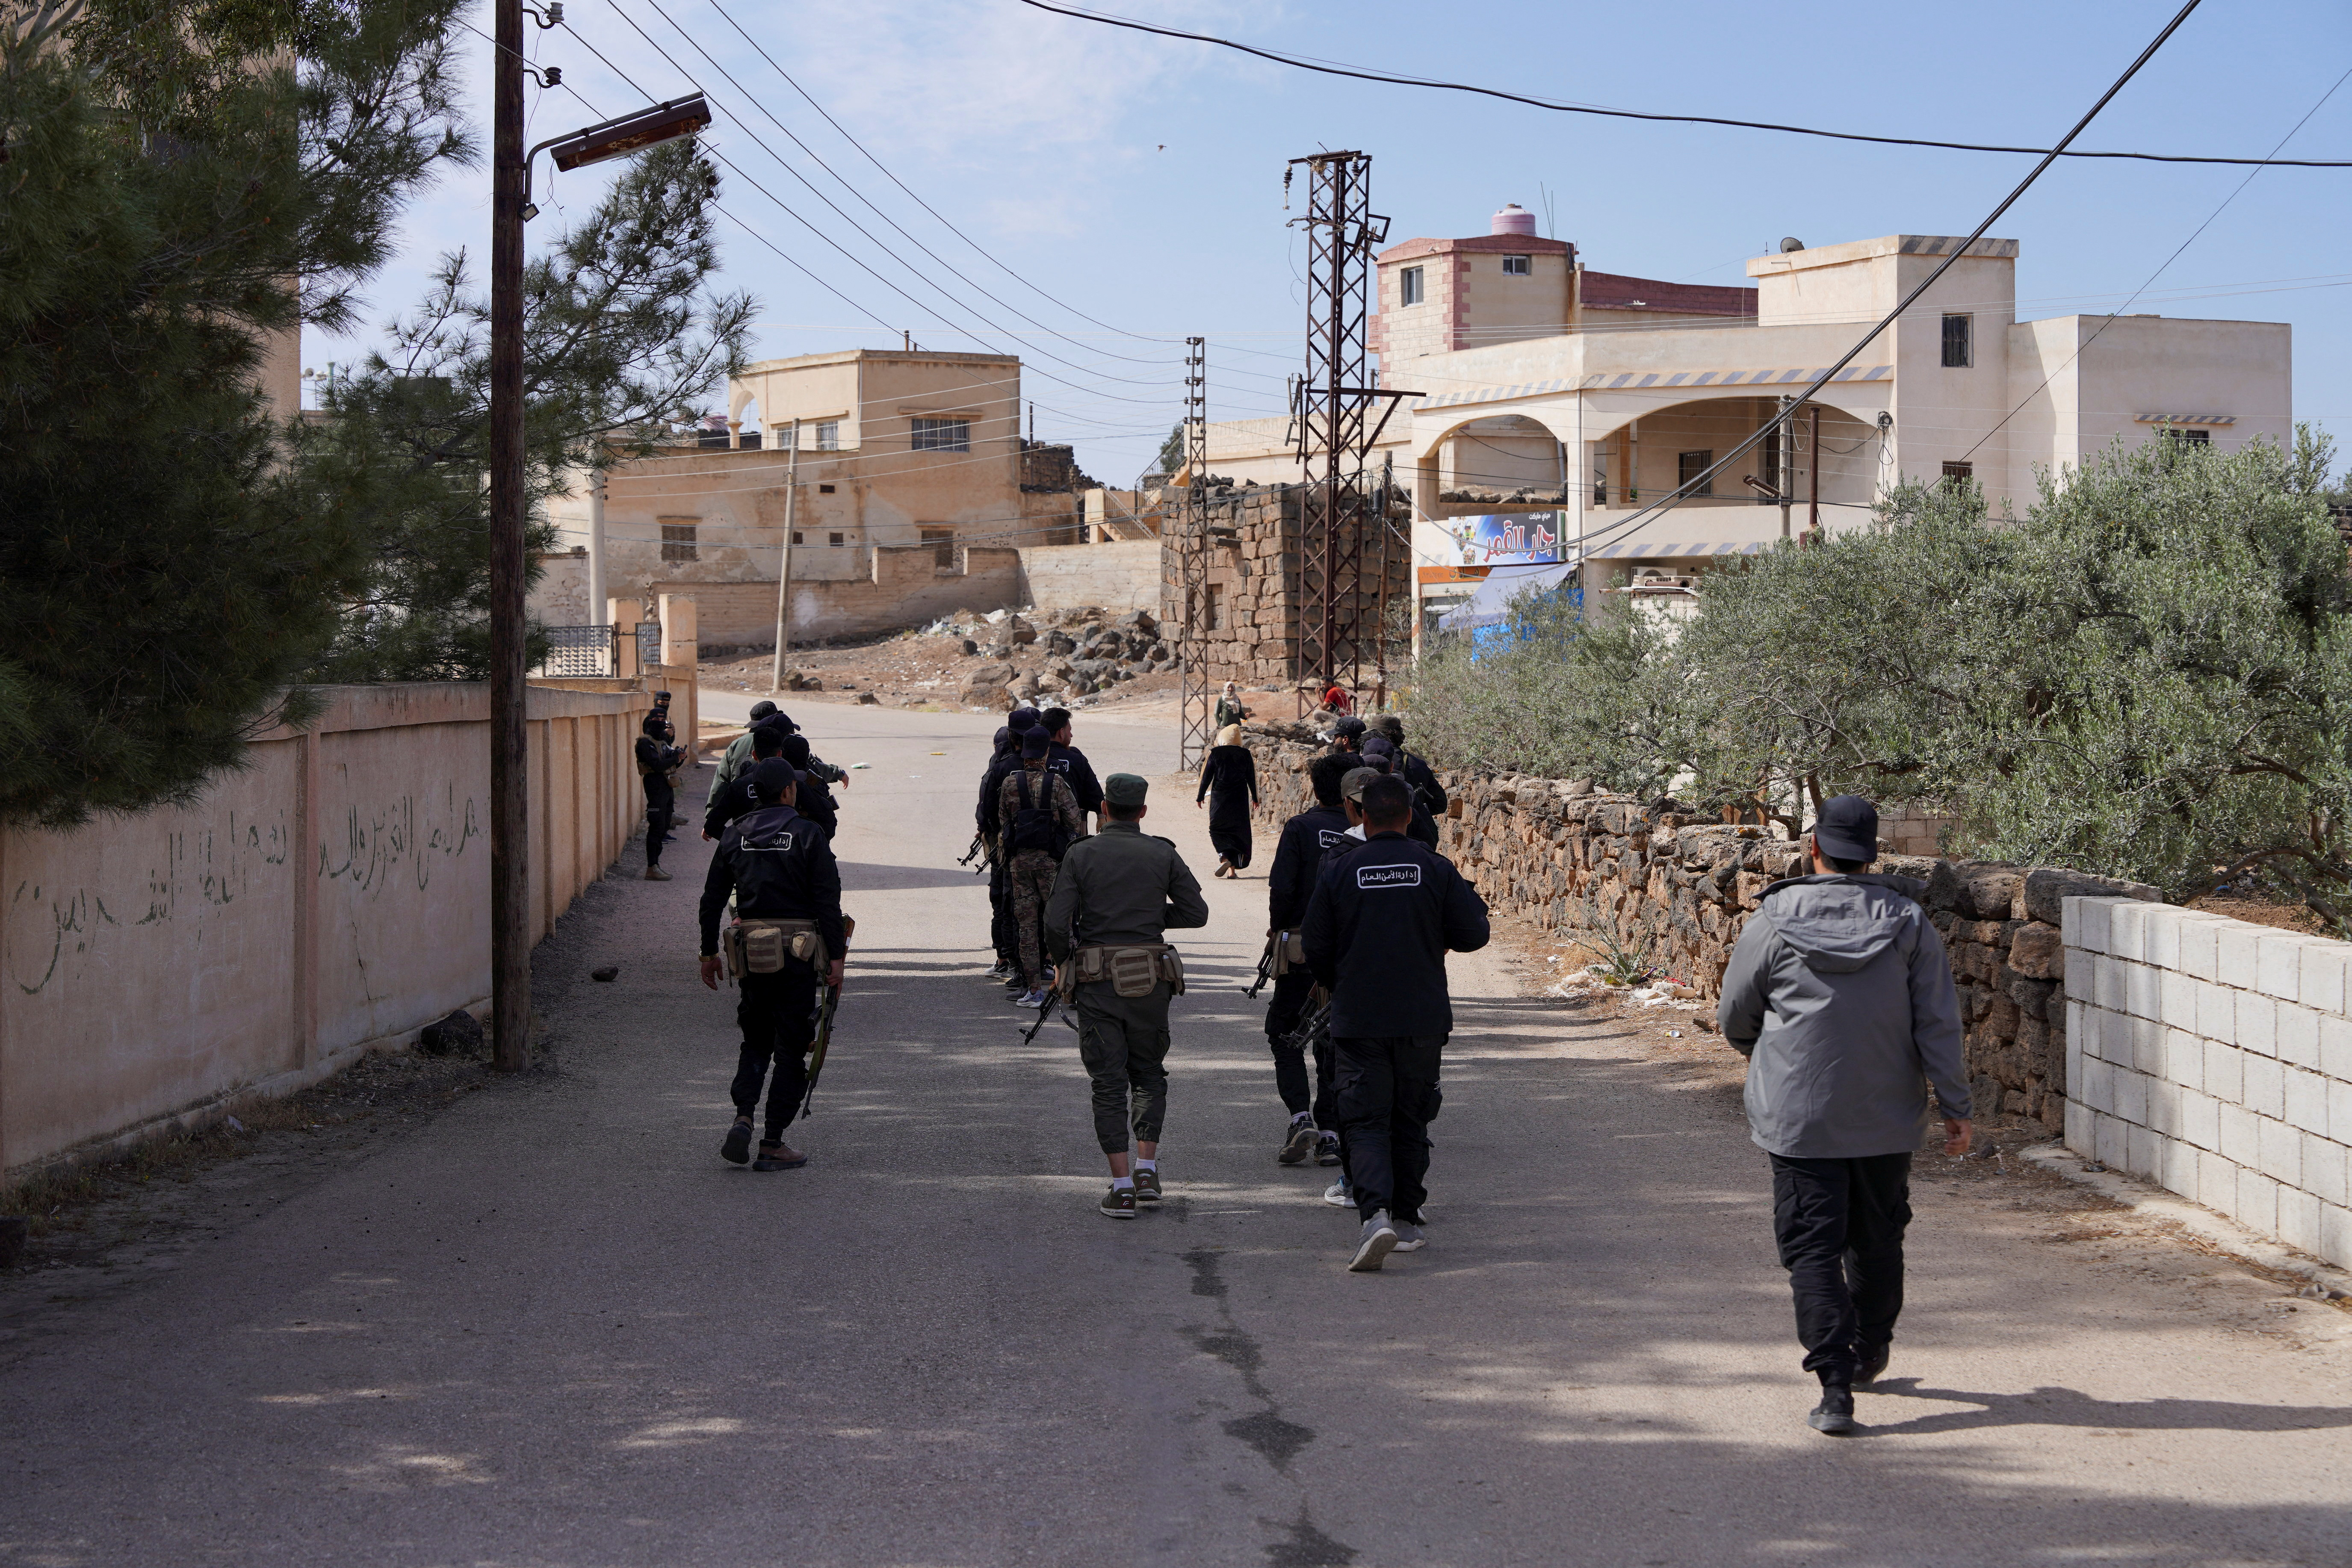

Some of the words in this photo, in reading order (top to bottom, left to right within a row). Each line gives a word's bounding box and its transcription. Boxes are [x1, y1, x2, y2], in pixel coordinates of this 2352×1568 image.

[1528, 512, 1541, 520] ماركت
[1542, 512, 1551, 521] ميني
[1482, 520, 1526, 564] القمر
[1526, 524, 1555, 563] جار
[773, 838, 789, 847] إدارة
[1322, 835, 1337, 844] العام
[1361, 872, 1381, 884] العام
[1381, 870, 1398, 881] الأمن
[1398, 870, 1417, 881] إدارة
